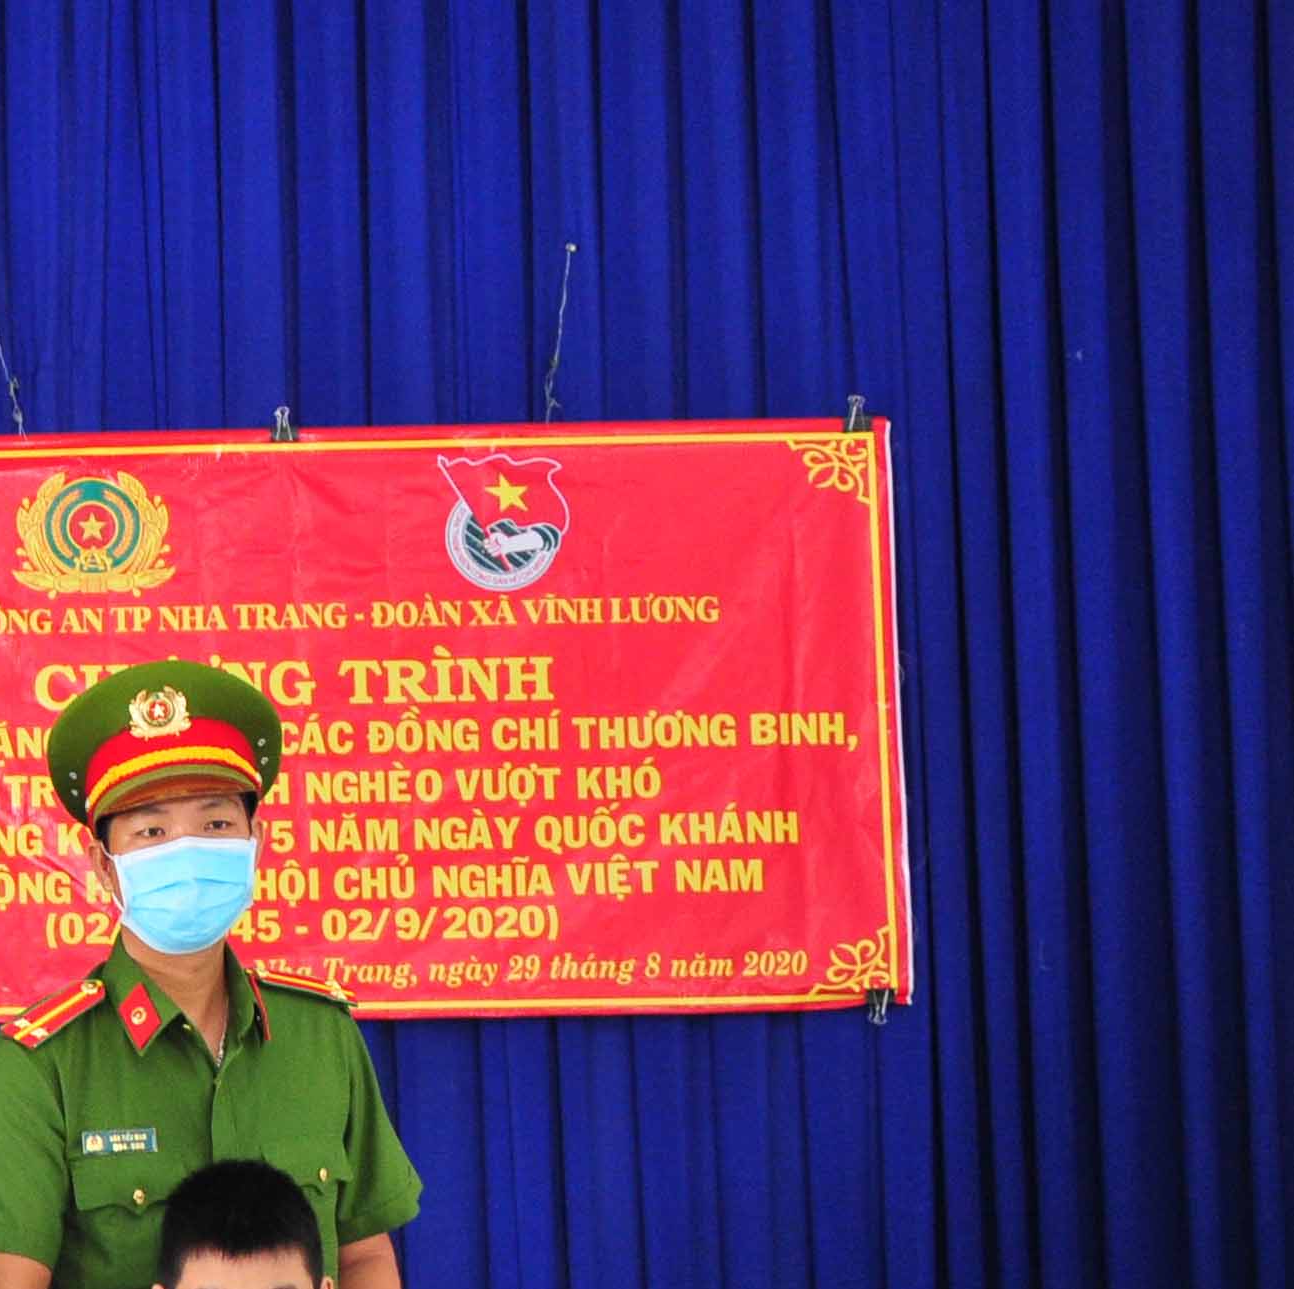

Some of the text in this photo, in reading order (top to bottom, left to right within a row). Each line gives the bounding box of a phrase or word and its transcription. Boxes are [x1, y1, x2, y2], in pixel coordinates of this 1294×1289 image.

[60, 607, 104, 634] AN
[114, 605, 153, 634] TP
[159, 604, 229, 632] NHA
[235, 602, 348, 631] TRANG
[370, 593, 462, 628] ĐOÀN
[469, 595, 518, 626] XÃ
[522, 592, 604, 625] VĨNH
[610, 592, 720, 624] LƯƠNG
[338, 644, 555, 705] TRÌNH
[281, 712, 354, 756] CÁC
[366, 706, 480, 754] ĐỒNG
[491, 708, 561, 752] CHÍ
[572, 709, 737, 750] THƯƠNG
[749, 712, 859, 752] BINH,
[3, 774, 55, 810] TR
[305, 761, 444, 805] NGHÈO
[455, 762, 562, 805] VƯỢT
[576, 756, 662, 800] KHÓ
[263, 819, 296, 855] 5
[308, 811, 400, 853] NĂM
[413, 809, 520, 852] NGÀY
[535, 801, 646, 855] QUỐC
[660, 802, 799, 846] KHÁNH
[253, 859, 320, 908] HỘI
[333, 853, 416, 901] CHỦ
[432, 856, 555, 899] NGHĨA
[566, 854, 660, 901] VIỆT
[675, 858, 764, 893] NAM
[320, 956, 418, 990] Trang,
[428, 956, 499, 988] ngày
[506, 954, 541, 981] 29
[549, 952, 637, 986] tháng
[644, 952, 662, 977] 8
[671, 953, 734, 978] năm
[742, 950, 808, 977] 2020
